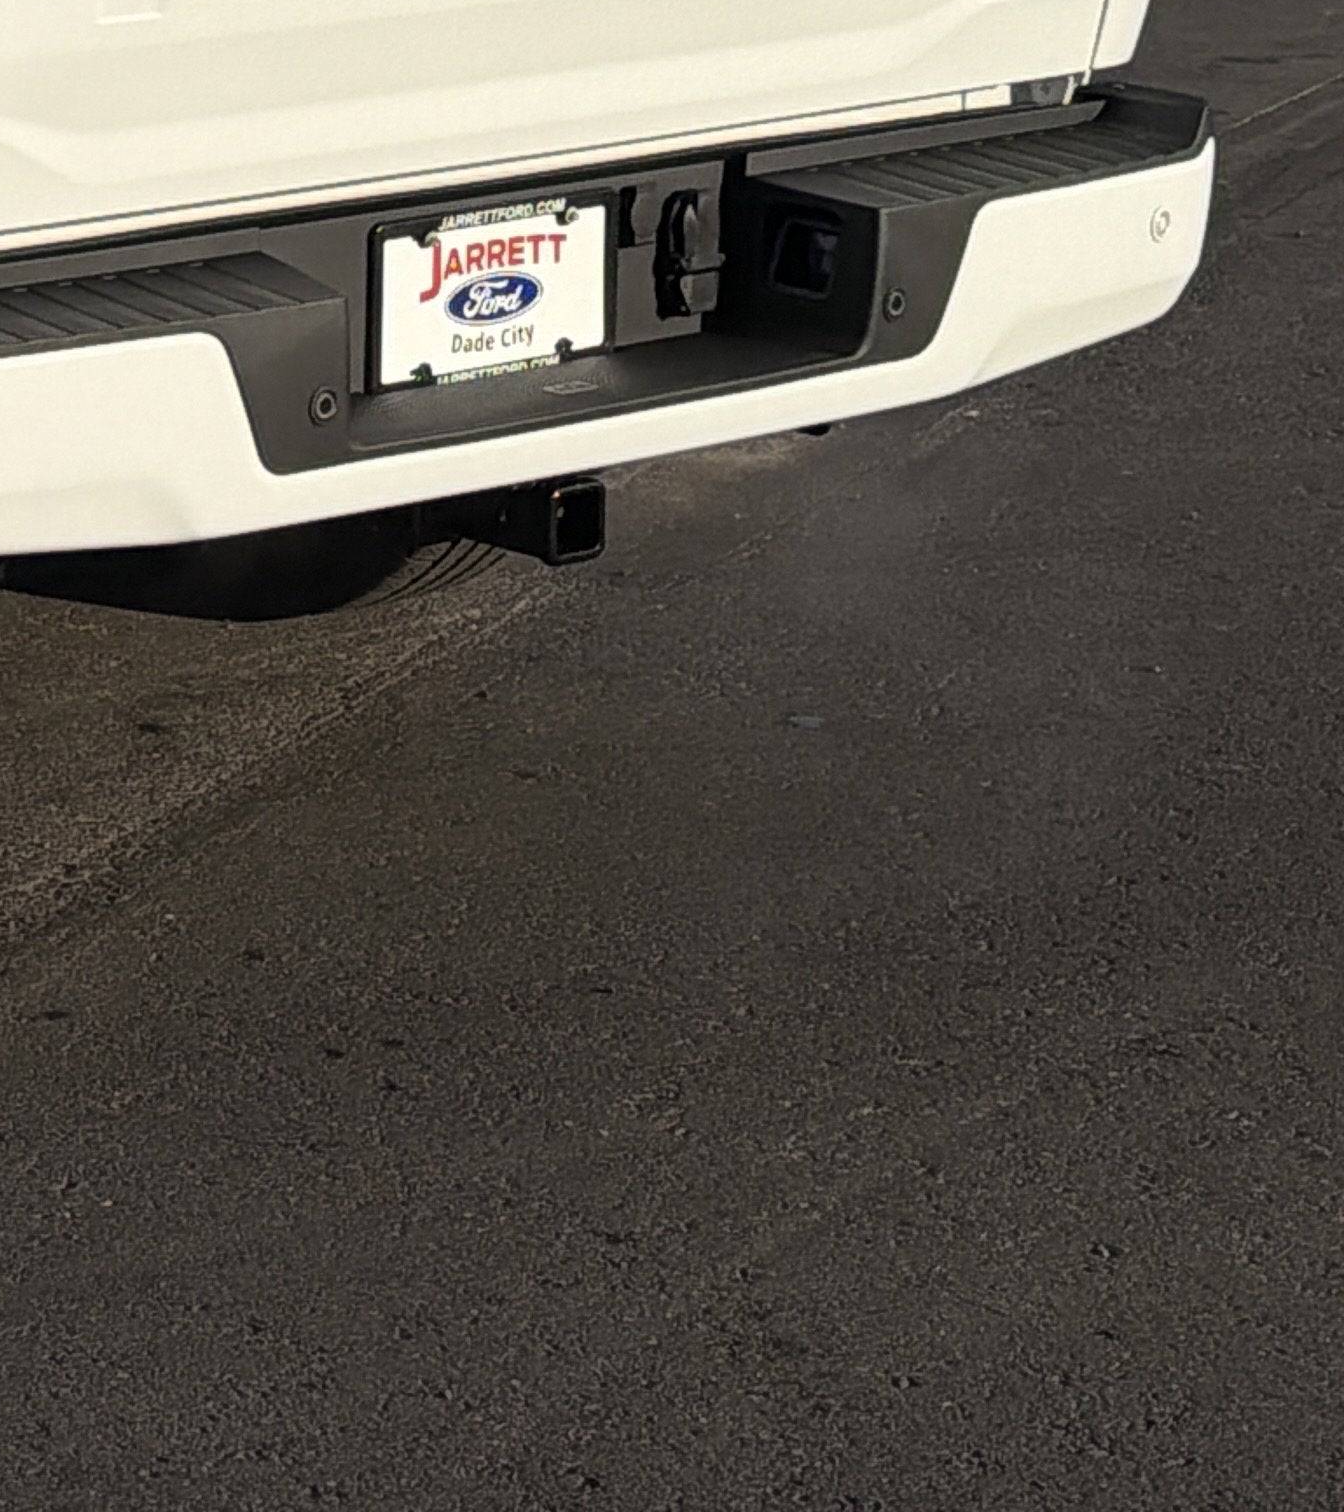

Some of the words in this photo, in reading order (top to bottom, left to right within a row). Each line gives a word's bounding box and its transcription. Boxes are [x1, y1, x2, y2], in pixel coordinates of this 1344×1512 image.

[419, 234, 567, 303] JARRETT
[463, 279, 523, 318] Ford
[451, 332, 495, 353] Dade
[501, 324, 535, 348] City
